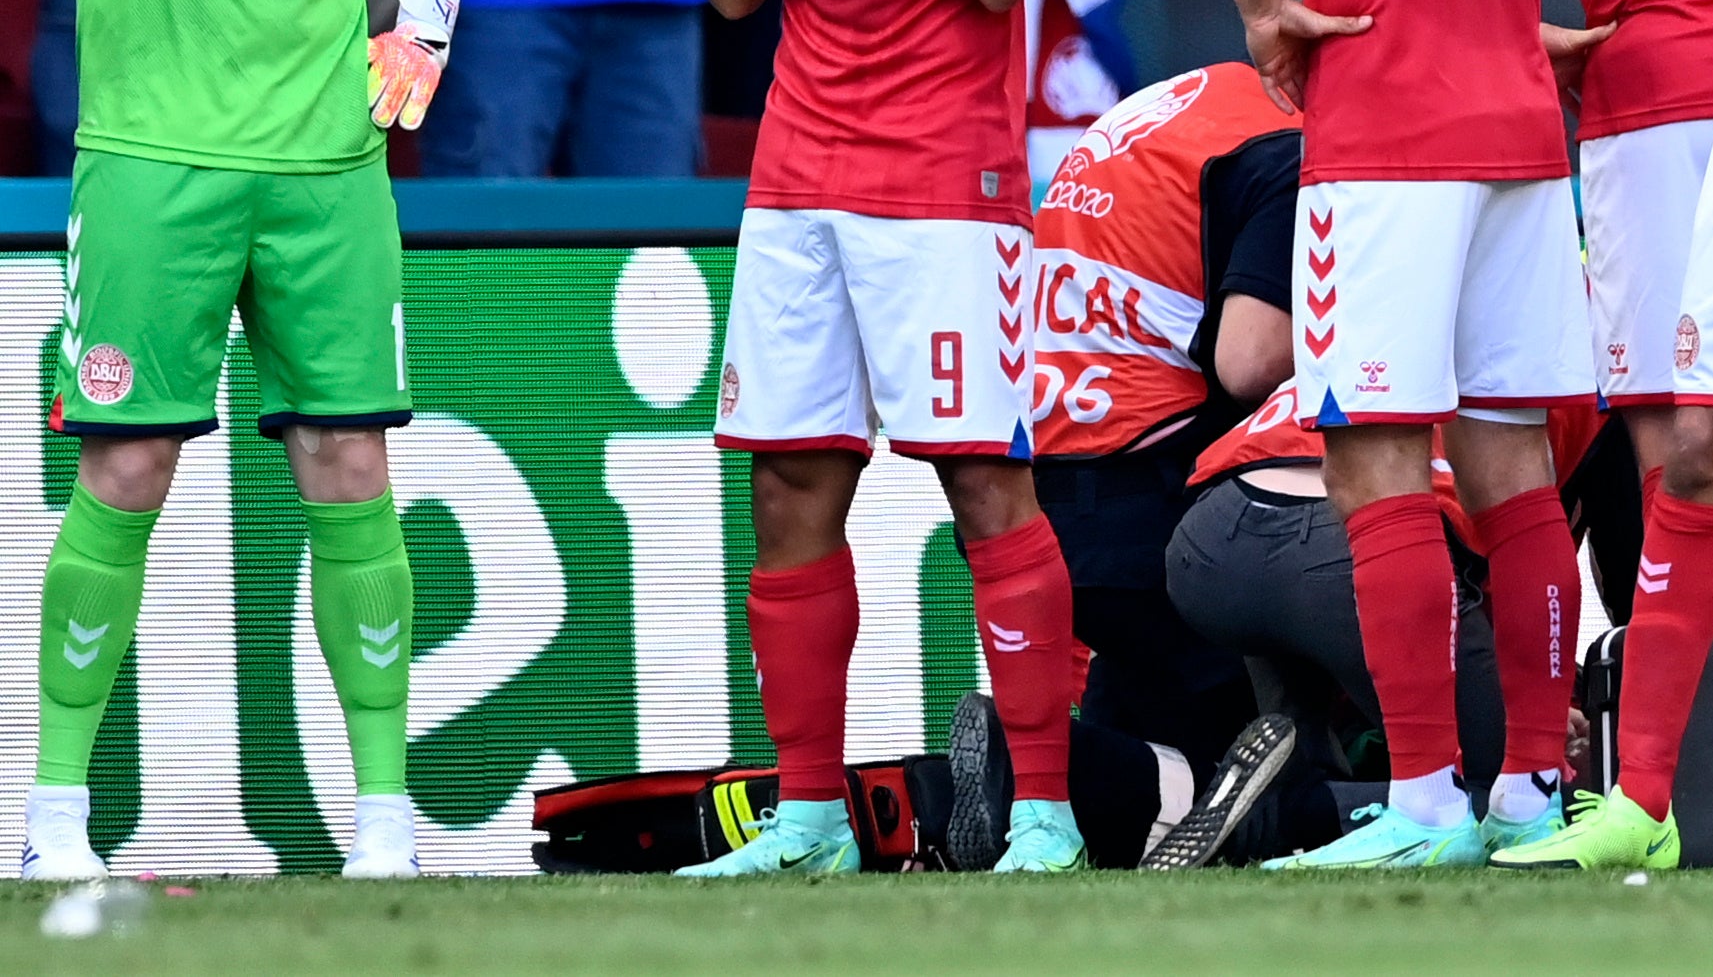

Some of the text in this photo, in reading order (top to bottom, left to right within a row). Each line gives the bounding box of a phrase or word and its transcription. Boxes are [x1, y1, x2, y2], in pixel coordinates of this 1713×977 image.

[90, 364, 121, 381] DBU
[391, 303, 405, 390] 1
[931, 330, 963, 419] 9
[1355, 383, 1390, 392] hummel
[1547, 584, 1561, 678] DANMARK
